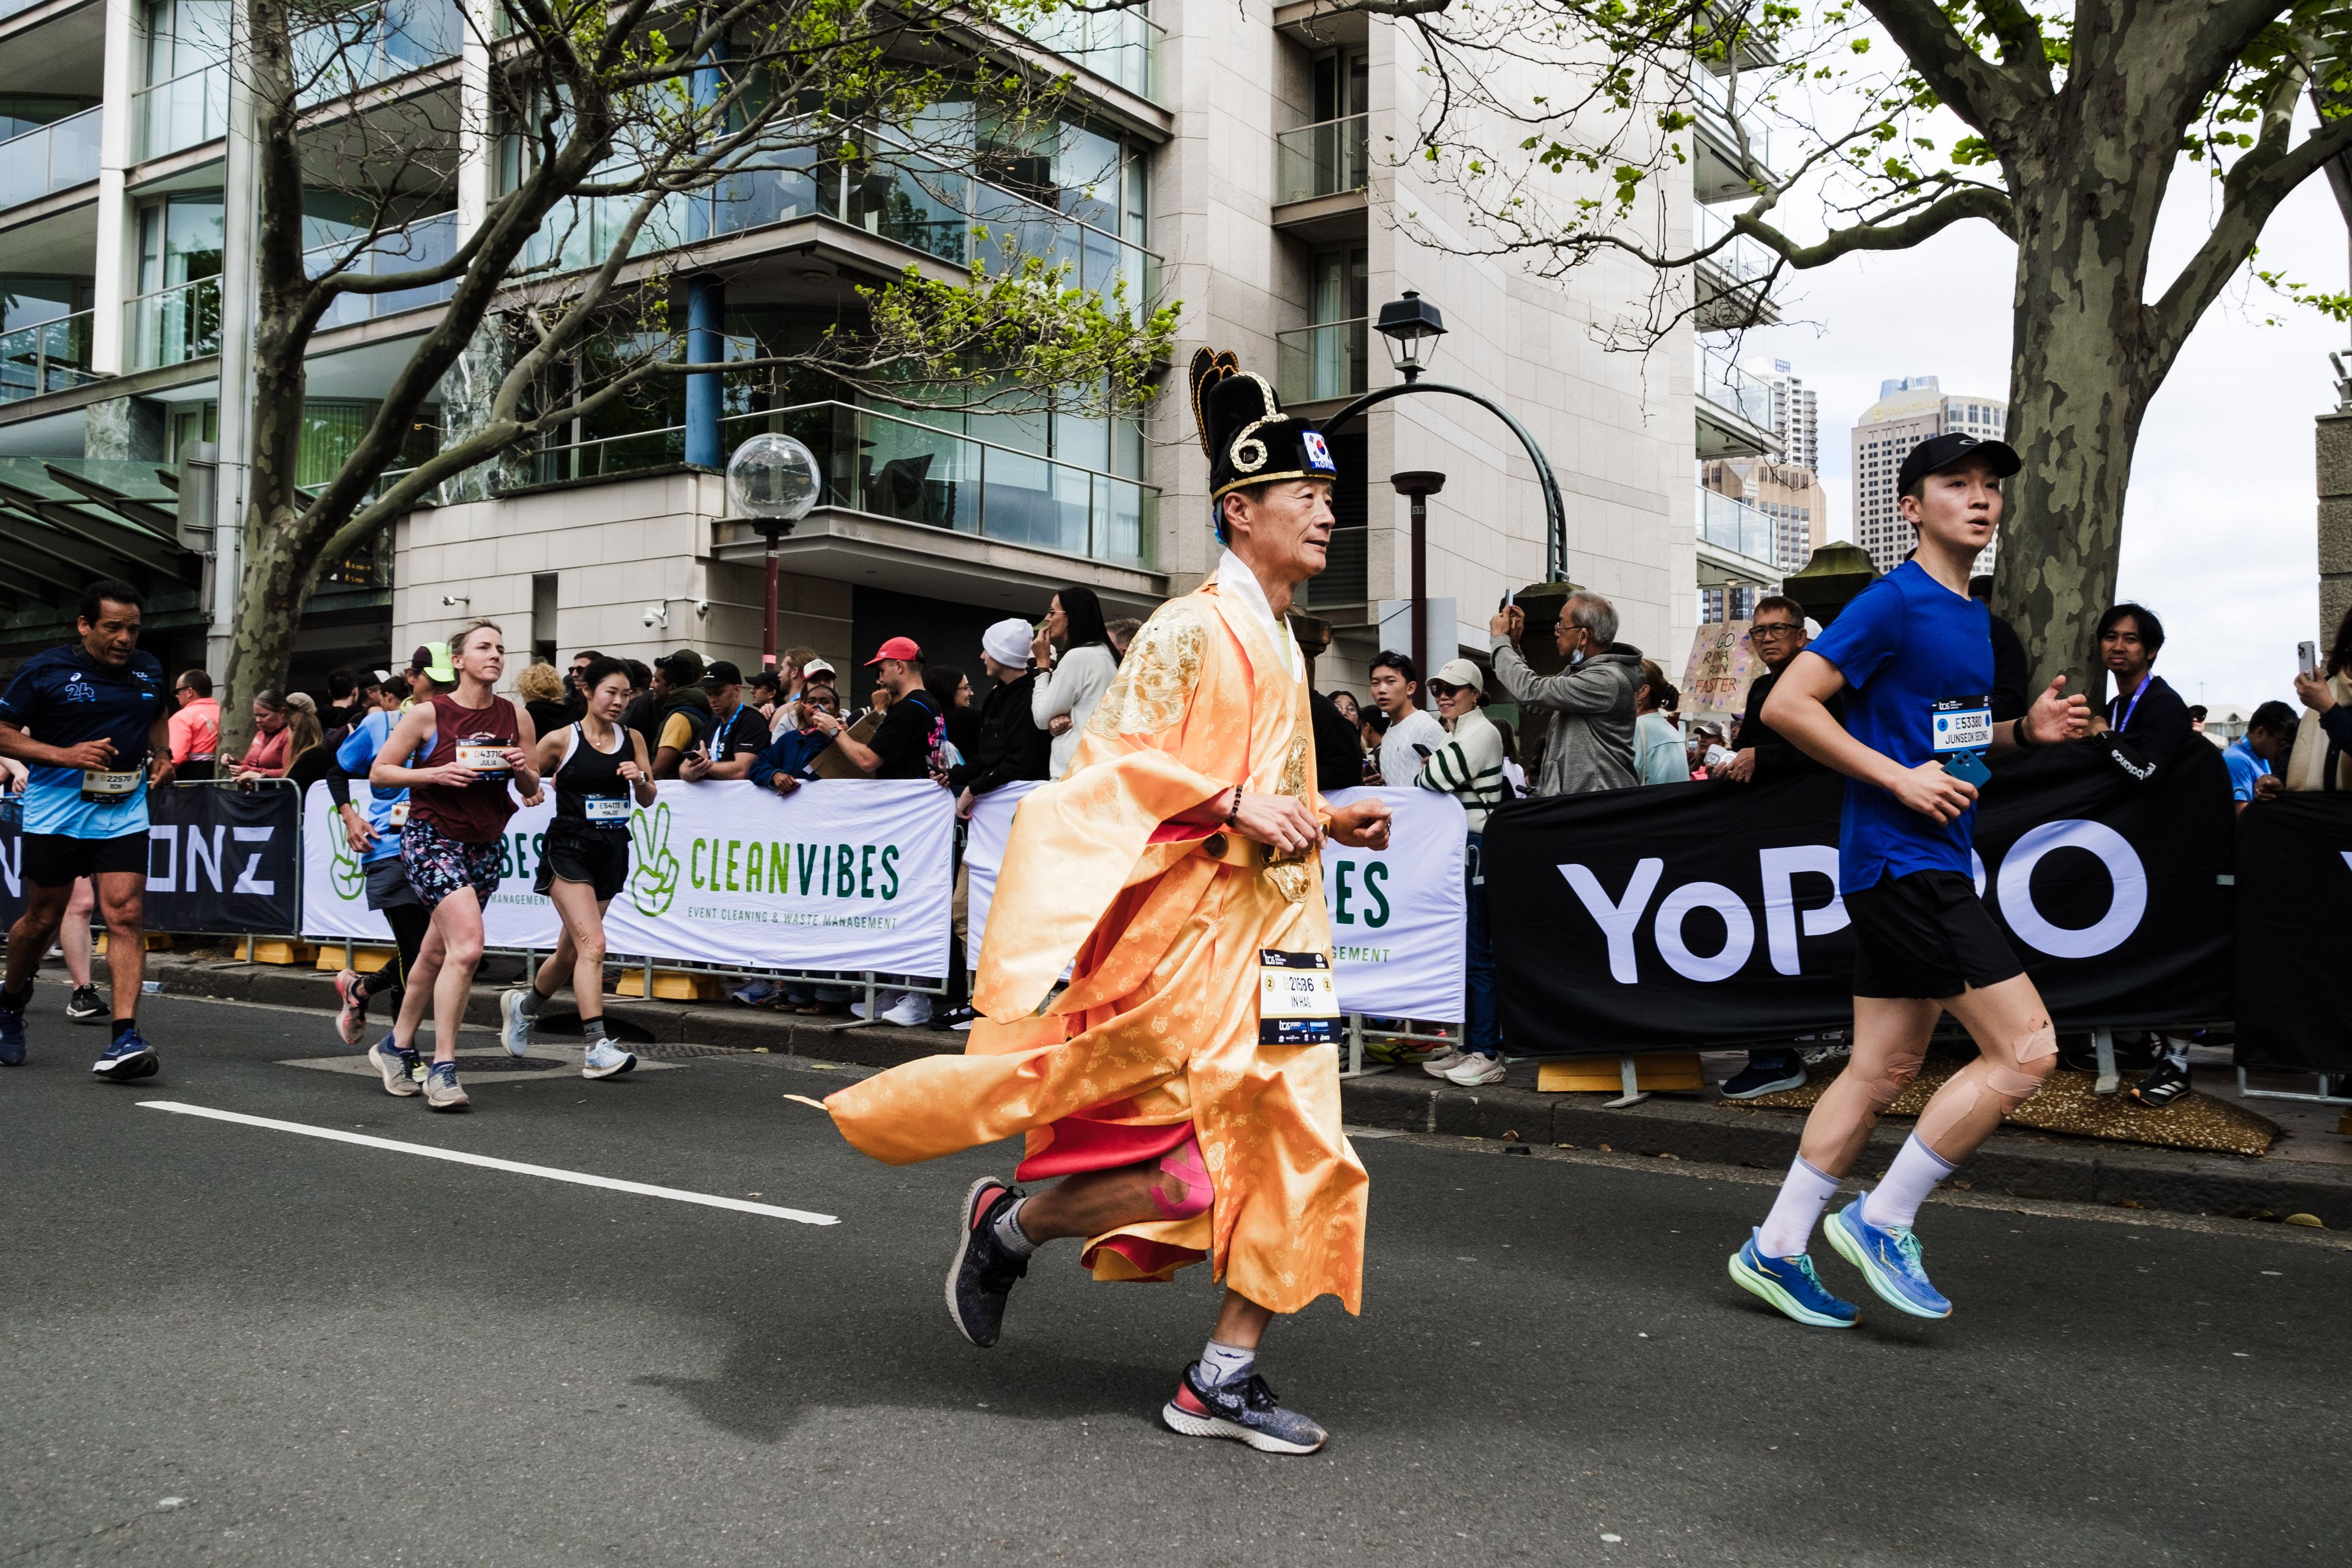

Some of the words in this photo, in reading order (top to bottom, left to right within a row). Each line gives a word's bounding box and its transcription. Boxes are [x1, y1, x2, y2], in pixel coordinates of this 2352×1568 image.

[1717, 633, 1735, 649] GO
[1703, 650, 1728, 664] RINA
[1708, 664, 1728, 676] RUN
[65, 683, 94, 701] 24
[1694, 677, 1737, 694] FASTER
[1945, 732, 1975, 744] JUNSEOK
[691, 838, 900, 900] CLEANVIBES
[491, 894, 550, 905] MANAGEMENT
[1556, 820, 2148, 984] YoPO
[688, 907, 717, 919] EVENT
[721, 909, 768, 923] CLEANING
[772, 912, 778, 924] &
[784, 913, 818, 926] WASTE
[823, 915, 898, 930] MANAGEMENT
